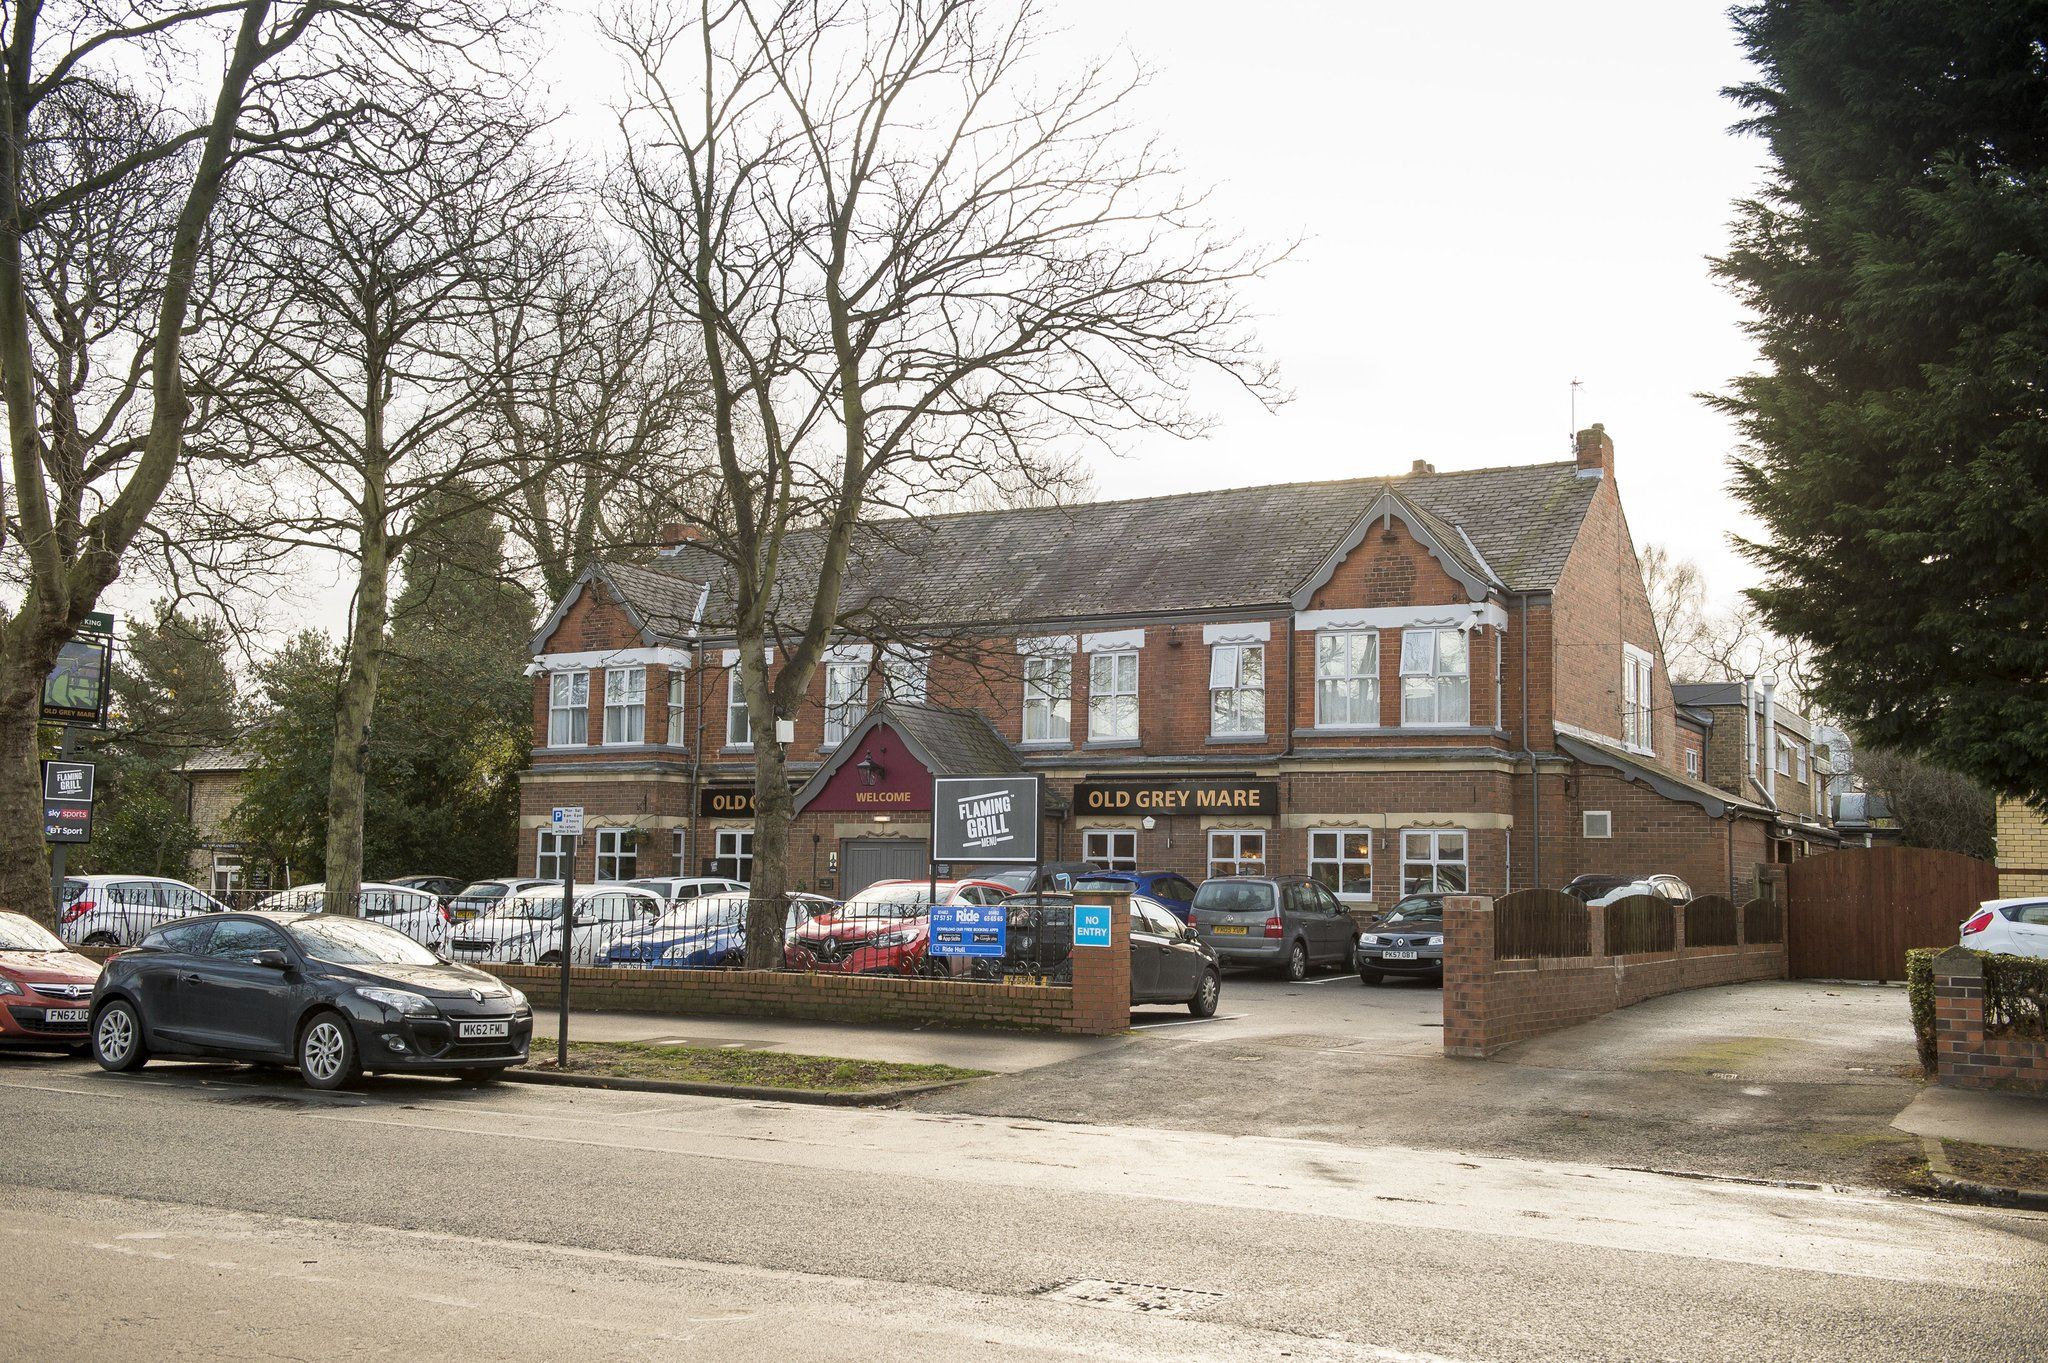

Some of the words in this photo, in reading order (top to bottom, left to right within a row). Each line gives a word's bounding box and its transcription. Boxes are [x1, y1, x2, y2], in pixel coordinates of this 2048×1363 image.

[84, 618, 102, 627] KING
[44, 707, 58, 715] OLD
[58, 708, 76, 716] GREY
[77, 710, 96, 718] MARE
[56, 772, 82, 782] FLAMING
[60, 780, 81, 790] GRILL
[856, 792, 911, 802] WELCOME
[1088, 790, 1130, 808] OLD
[1136, 790, 1190, 808] GREY
[1196, 789, 1260, 807] MARE
[712, 795, 746, 810] OLD
[958, 796, 1011, 820] FLAMING
[48, 810, 60, 818] sky
[556, 811, 562, 821] P
[966, 814, 1010, 838] GRILL
[981, 836, 997, 848] MENU
[956, 908, 980, 922] Ride
[1085, 916, 1098, 925] NO
[1078, 928, 1107, 936] ENTRY
[50, 1010, 76, 1020] FN62
[464, 1024, 487, 1035] MK62
[490, 1024, 505, 1035] FML
